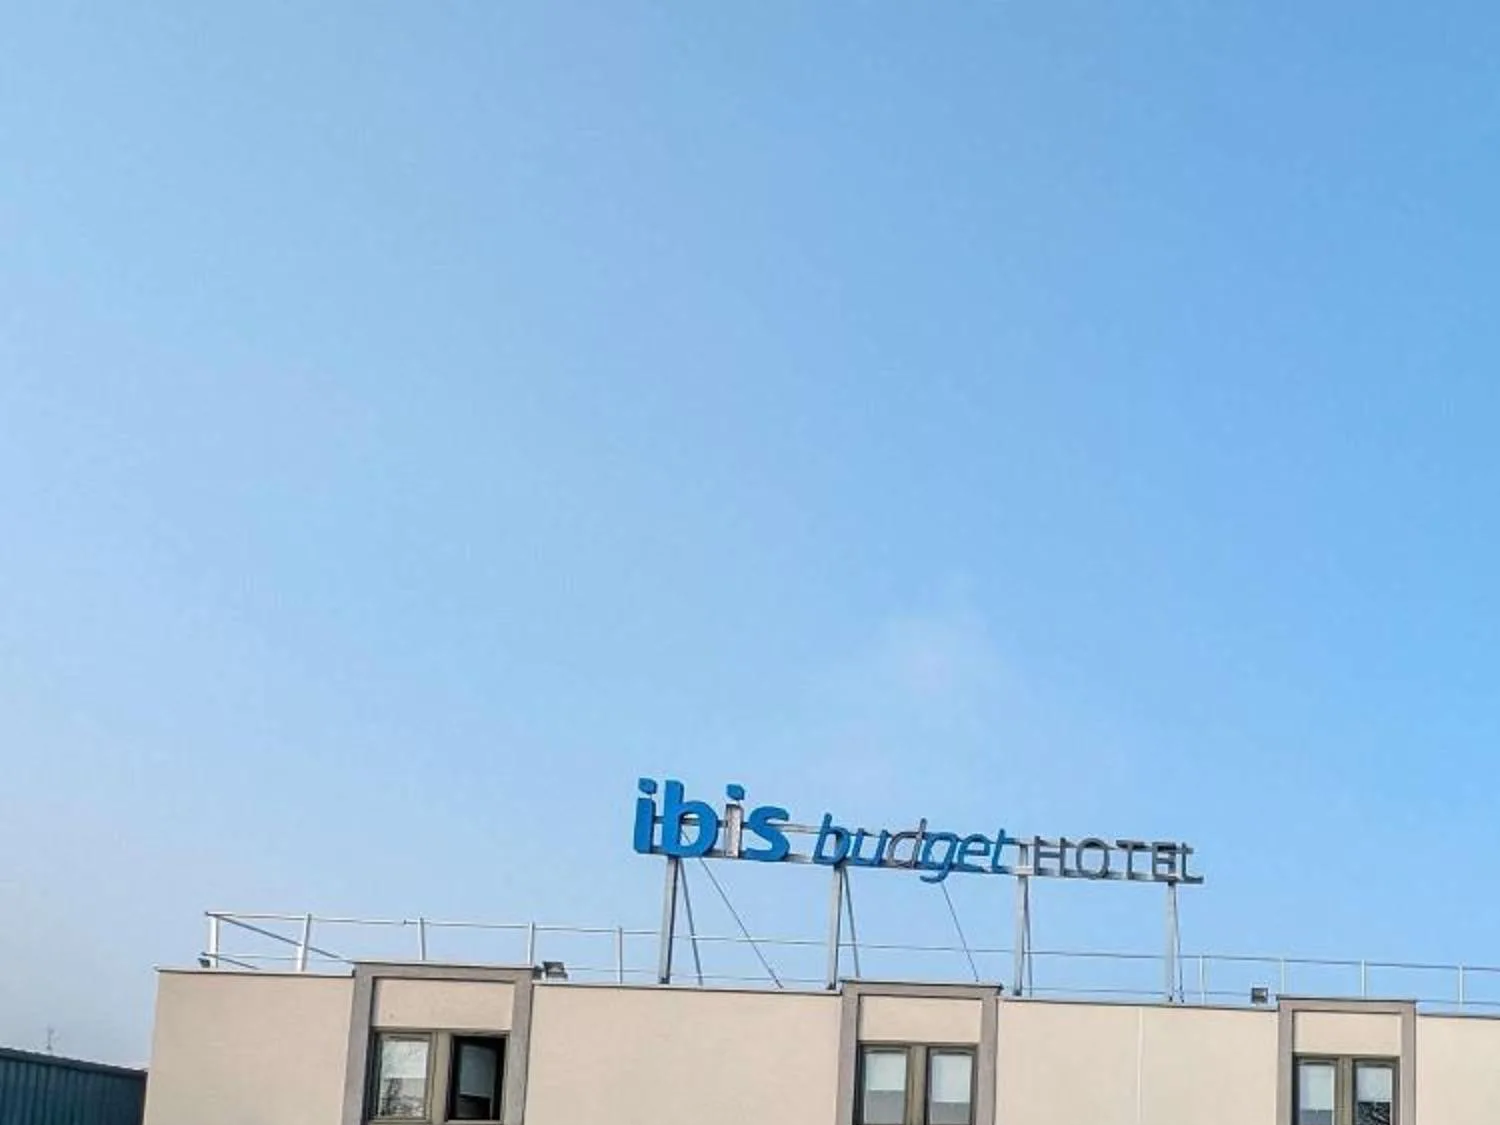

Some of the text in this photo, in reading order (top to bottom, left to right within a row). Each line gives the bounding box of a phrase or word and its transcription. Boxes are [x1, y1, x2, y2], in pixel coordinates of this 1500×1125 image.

[633, 777, 1204, 885] ibis budget HOTEL
